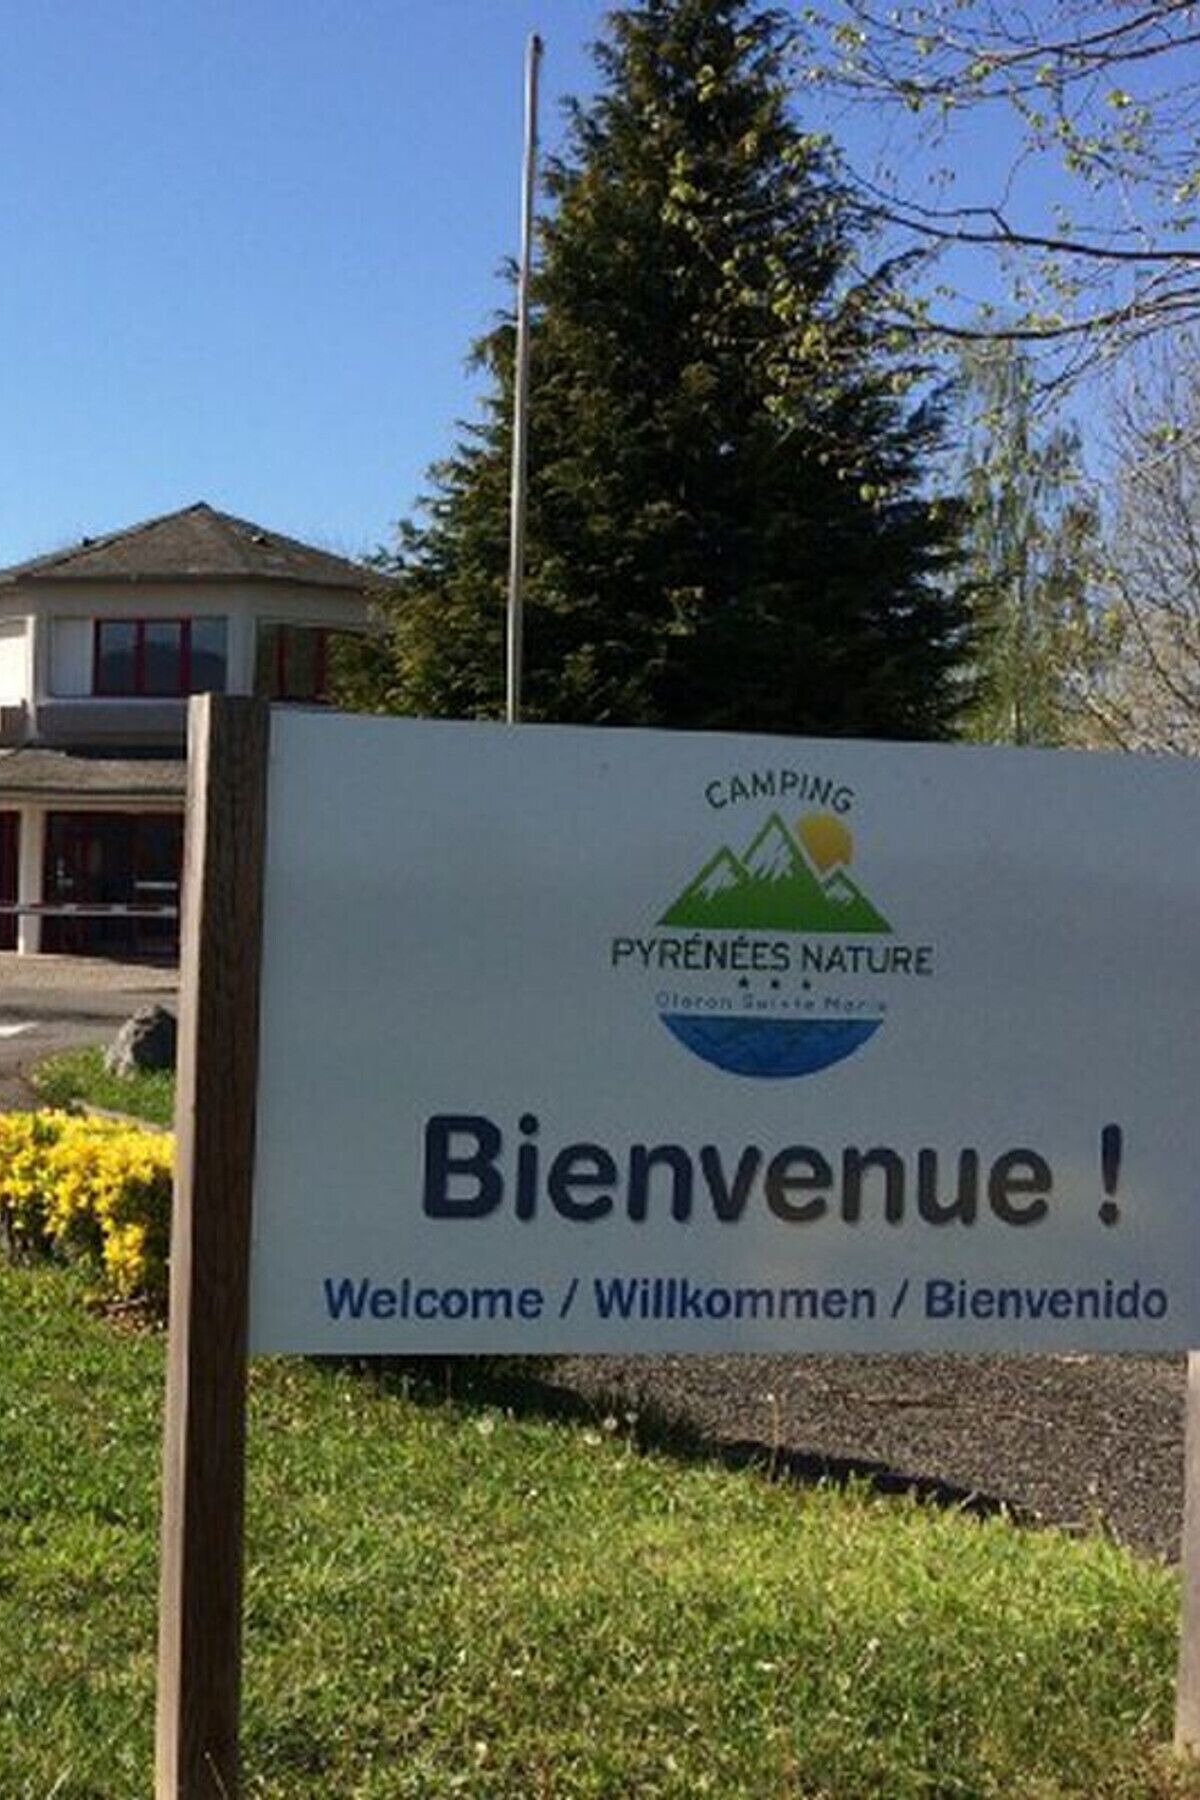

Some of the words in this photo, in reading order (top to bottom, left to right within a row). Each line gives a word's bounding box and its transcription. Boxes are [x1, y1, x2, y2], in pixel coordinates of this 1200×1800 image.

[705, 770, 854, 813] CAMPING
[612, 933, 790, 971] PYRÉNÉES
[803, 944, 933, 977] NATURE
[422, 1112, 1053, 1228] Bienvenue
[324, 1277, 544, 1320] Welcome
[594, 1277, 876, 1320] Willkommen
[925, 1279, 1167, 1319] Bienvenido
